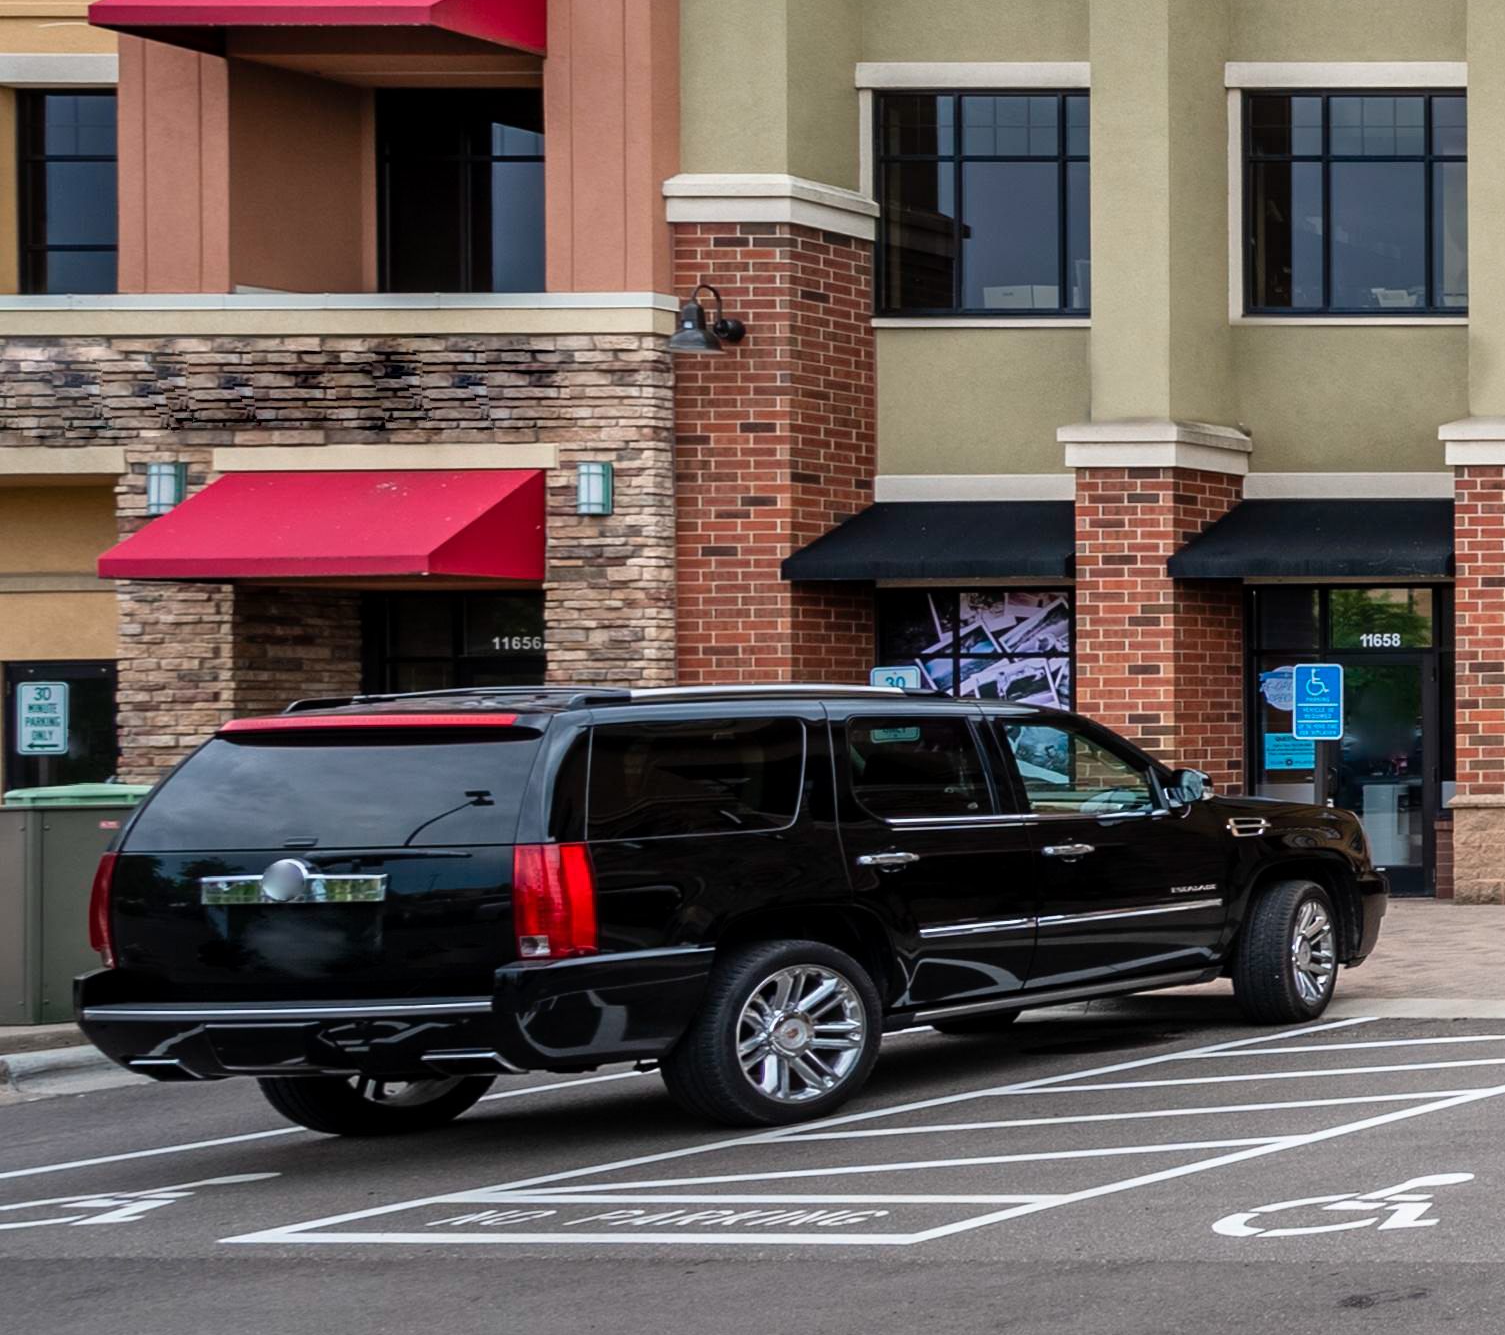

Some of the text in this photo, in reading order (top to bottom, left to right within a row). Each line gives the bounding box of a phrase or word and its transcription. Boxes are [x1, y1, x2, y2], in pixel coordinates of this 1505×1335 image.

[492, 636, 542, 650] 11656
[1360, 633, 1401, 647] 11658
[34, 687, 52, 701] 30
[25, 717, 61, 727] PARKING
[426, 1209, 889, 1226] NO PARKING
